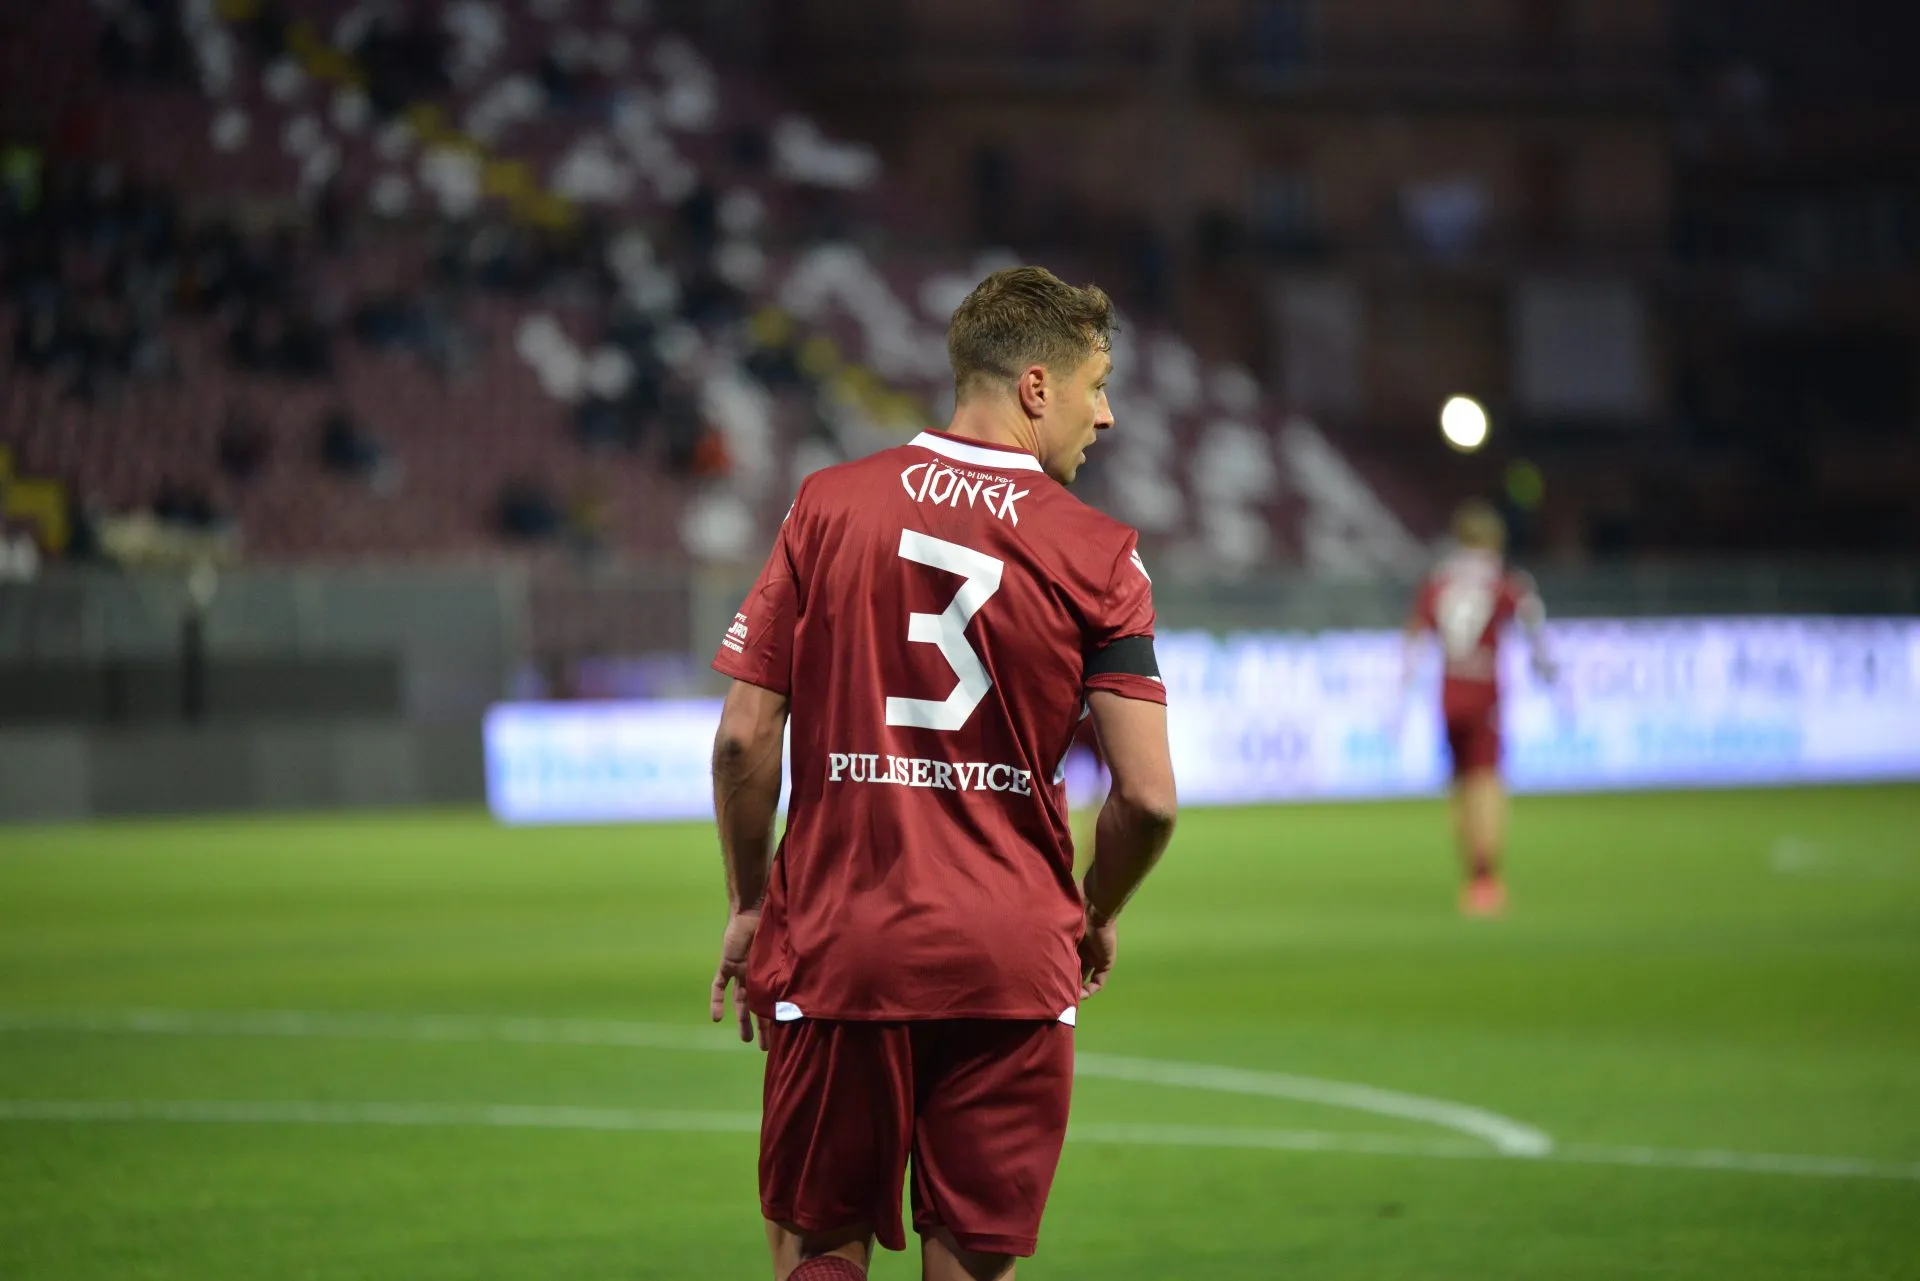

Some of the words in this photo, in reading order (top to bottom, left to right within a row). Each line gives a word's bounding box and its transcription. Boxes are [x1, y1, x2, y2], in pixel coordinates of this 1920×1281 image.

[901, 462, 1030, 528] CIONEK
[885, 528, 1004, 731] 3
[828, 752, 1032, 797] PULISERVICE
